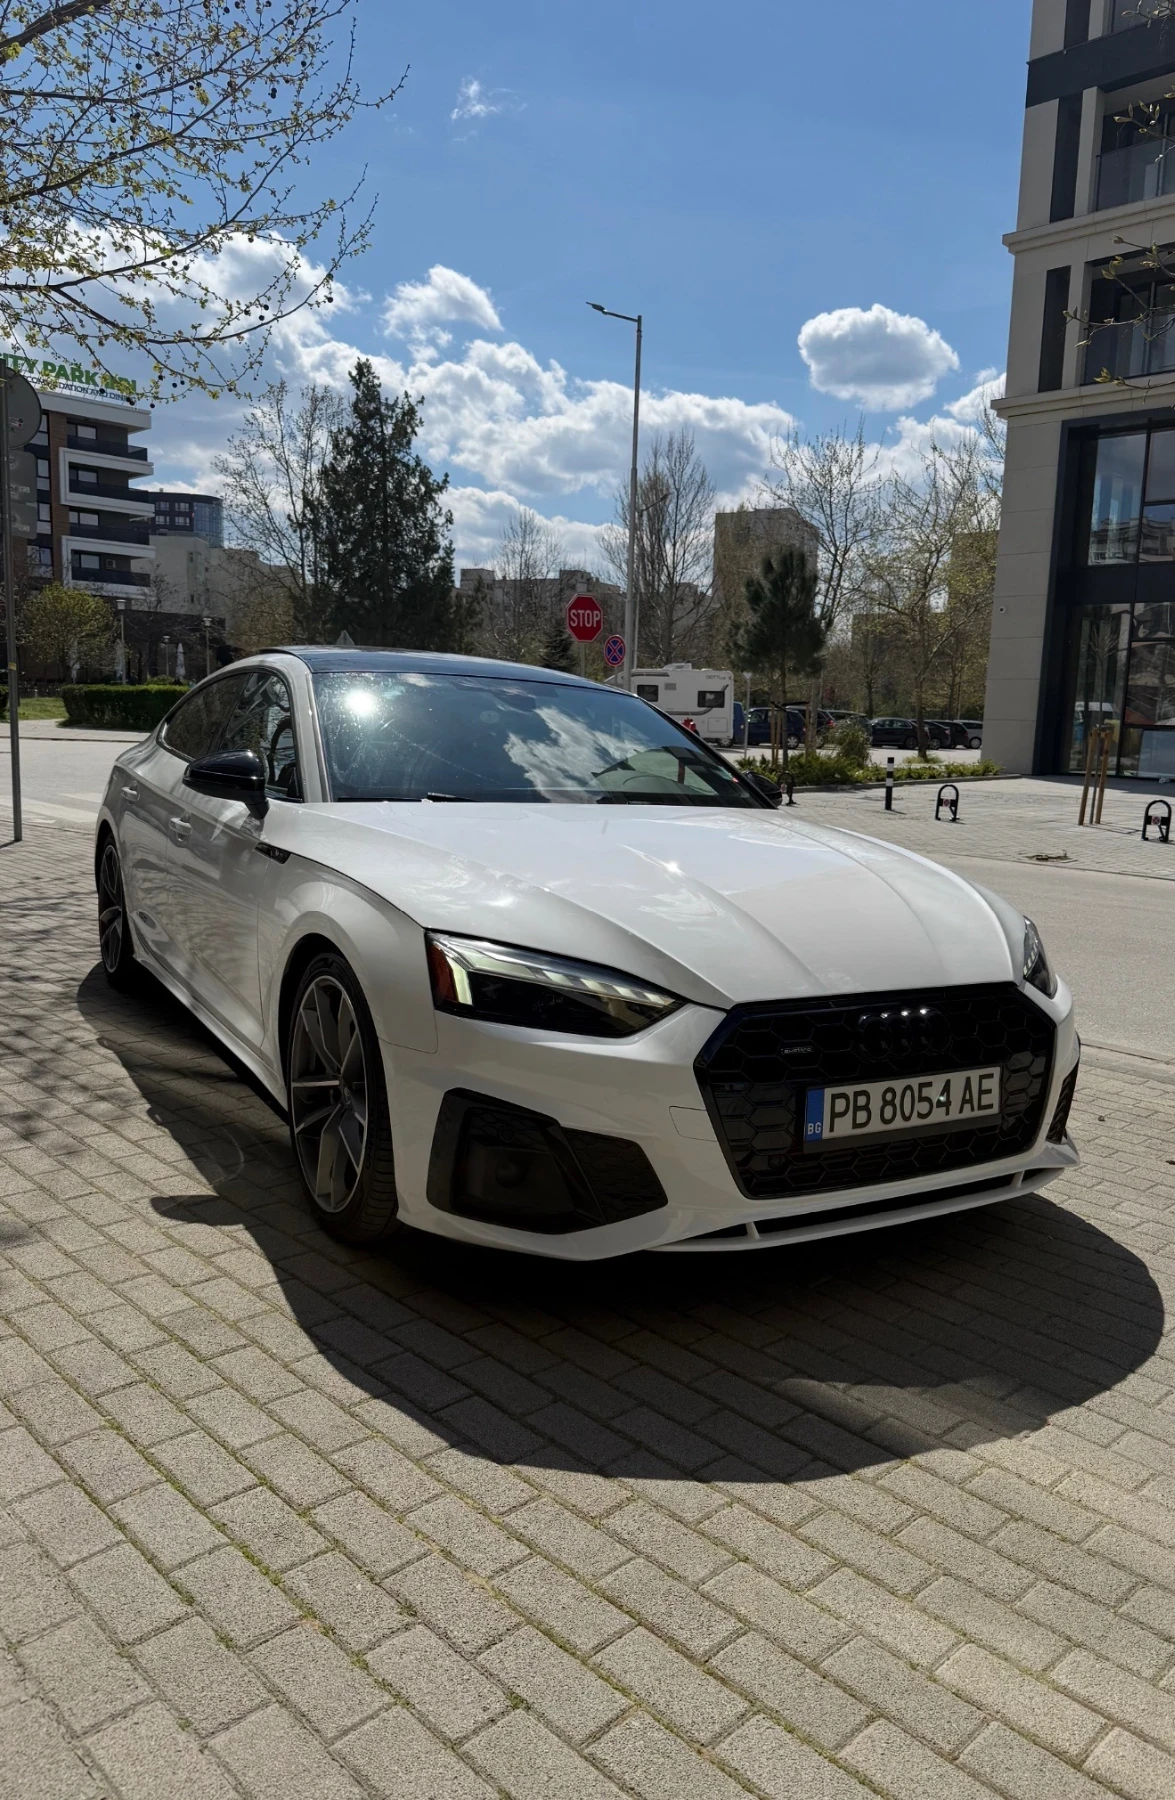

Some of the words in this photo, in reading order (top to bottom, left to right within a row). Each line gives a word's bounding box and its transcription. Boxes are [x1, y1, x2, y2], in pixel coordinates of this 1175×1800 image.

[0, 353, 39, 374] ITY
[43, 361, 100, 387] PARK
[570, 609, 600, 628] STOP
[829, 1090, 872, 1133] PB
[880, 1079, 952, 1125] 8054
[958, 1073, 995, 1114] AE
[807, 1122, 822, 1135] BG
